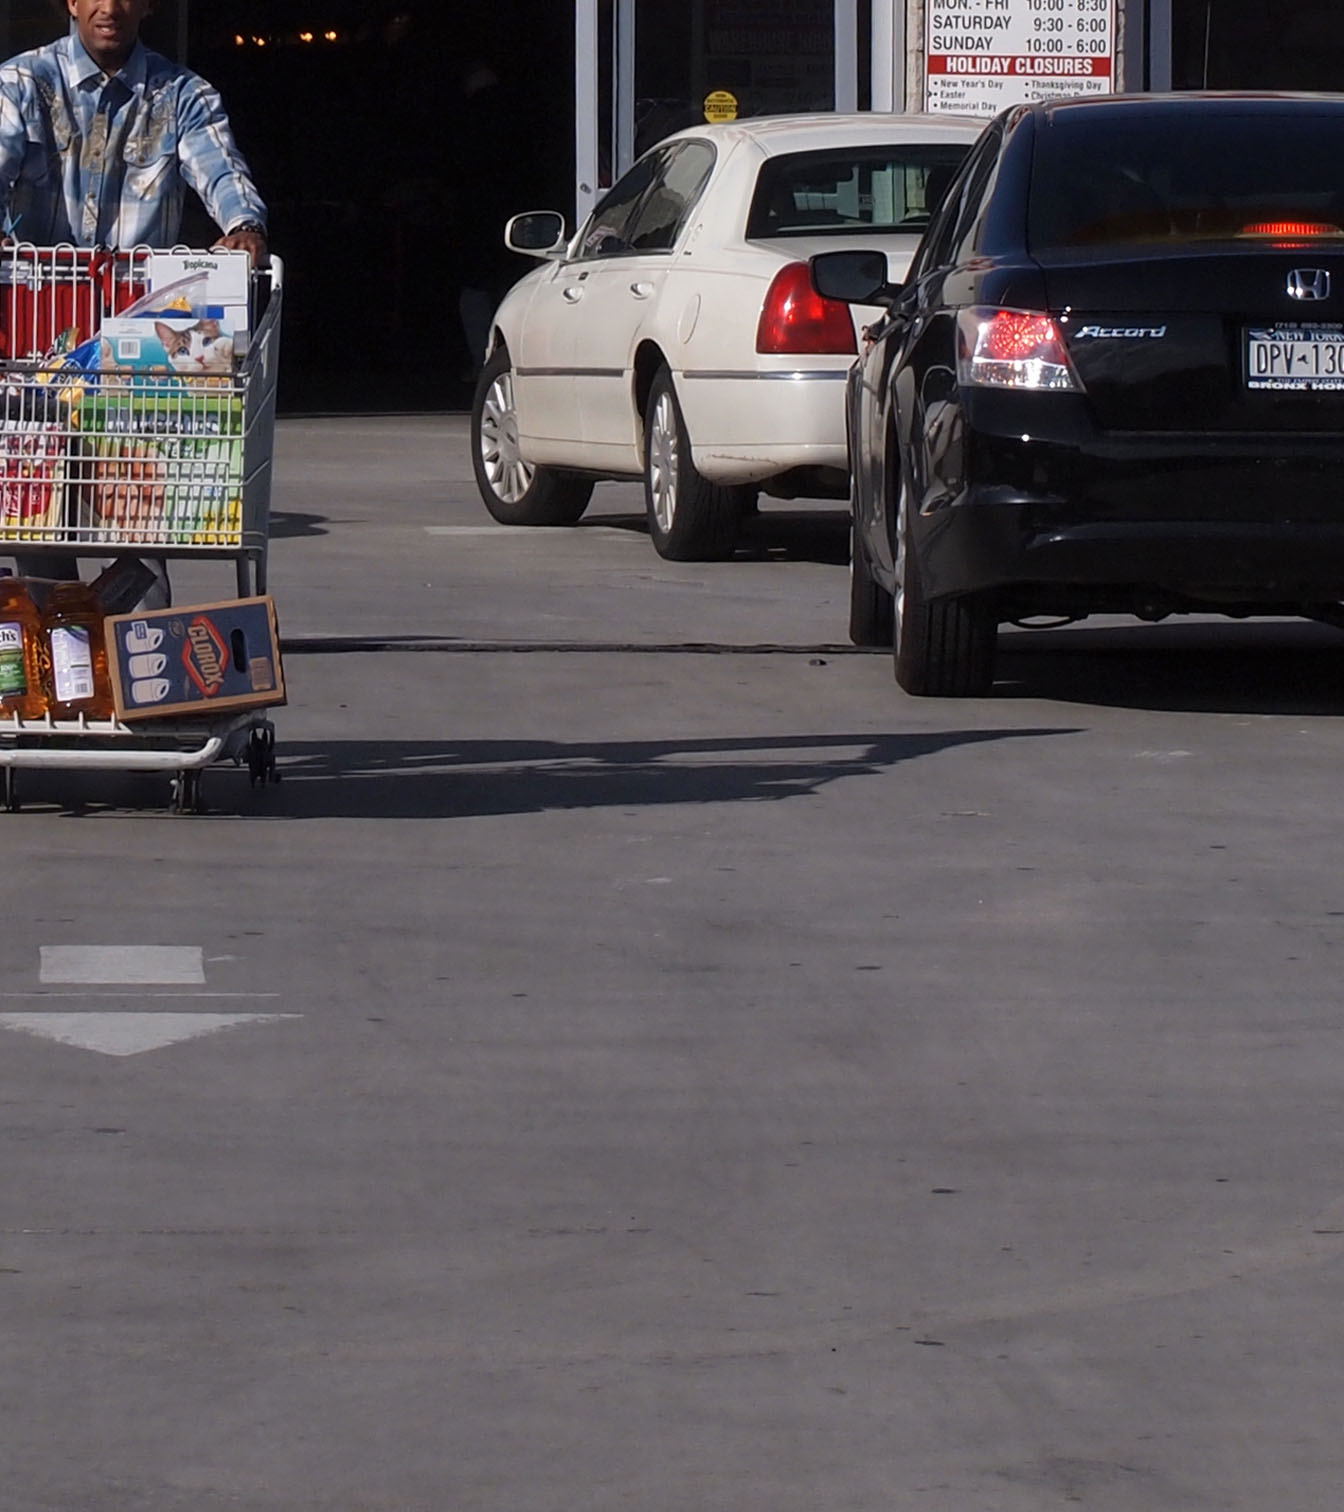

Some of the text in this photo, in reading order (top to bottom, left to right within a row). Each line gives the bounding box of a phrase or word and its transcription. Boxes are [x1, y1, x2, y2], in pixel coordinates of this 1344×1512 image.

[933, 16, 1012, 31] SATURDAY
[1033, 18, 1064, 32] 9:30
[1076, 18, 1107, 32] 6:00
[932, 36, 993, 51] SUNDAY
[1025, 39, 1064, 53] 10:00
[1076, 39, 1107, 53] 6:00
[946, 56, 1093, 75] HOLIDAY CLOSURES
[940, 79, 1003, 91] New Year's Day
[1031, 80, 1102, 92] Thanksgiving Day
[940, 90, 966, 99] Easter
[940, 102, 997, 113] Memorial Day
[183, 259, 218, 271] Tropicana
[1074, 325, 1167, 338] Accord
[1276, 331, 1344, 342] NEW YORK
[1248, 381, 1307, 389] BRONX
[187, 625, 225, 685] CLOROX
